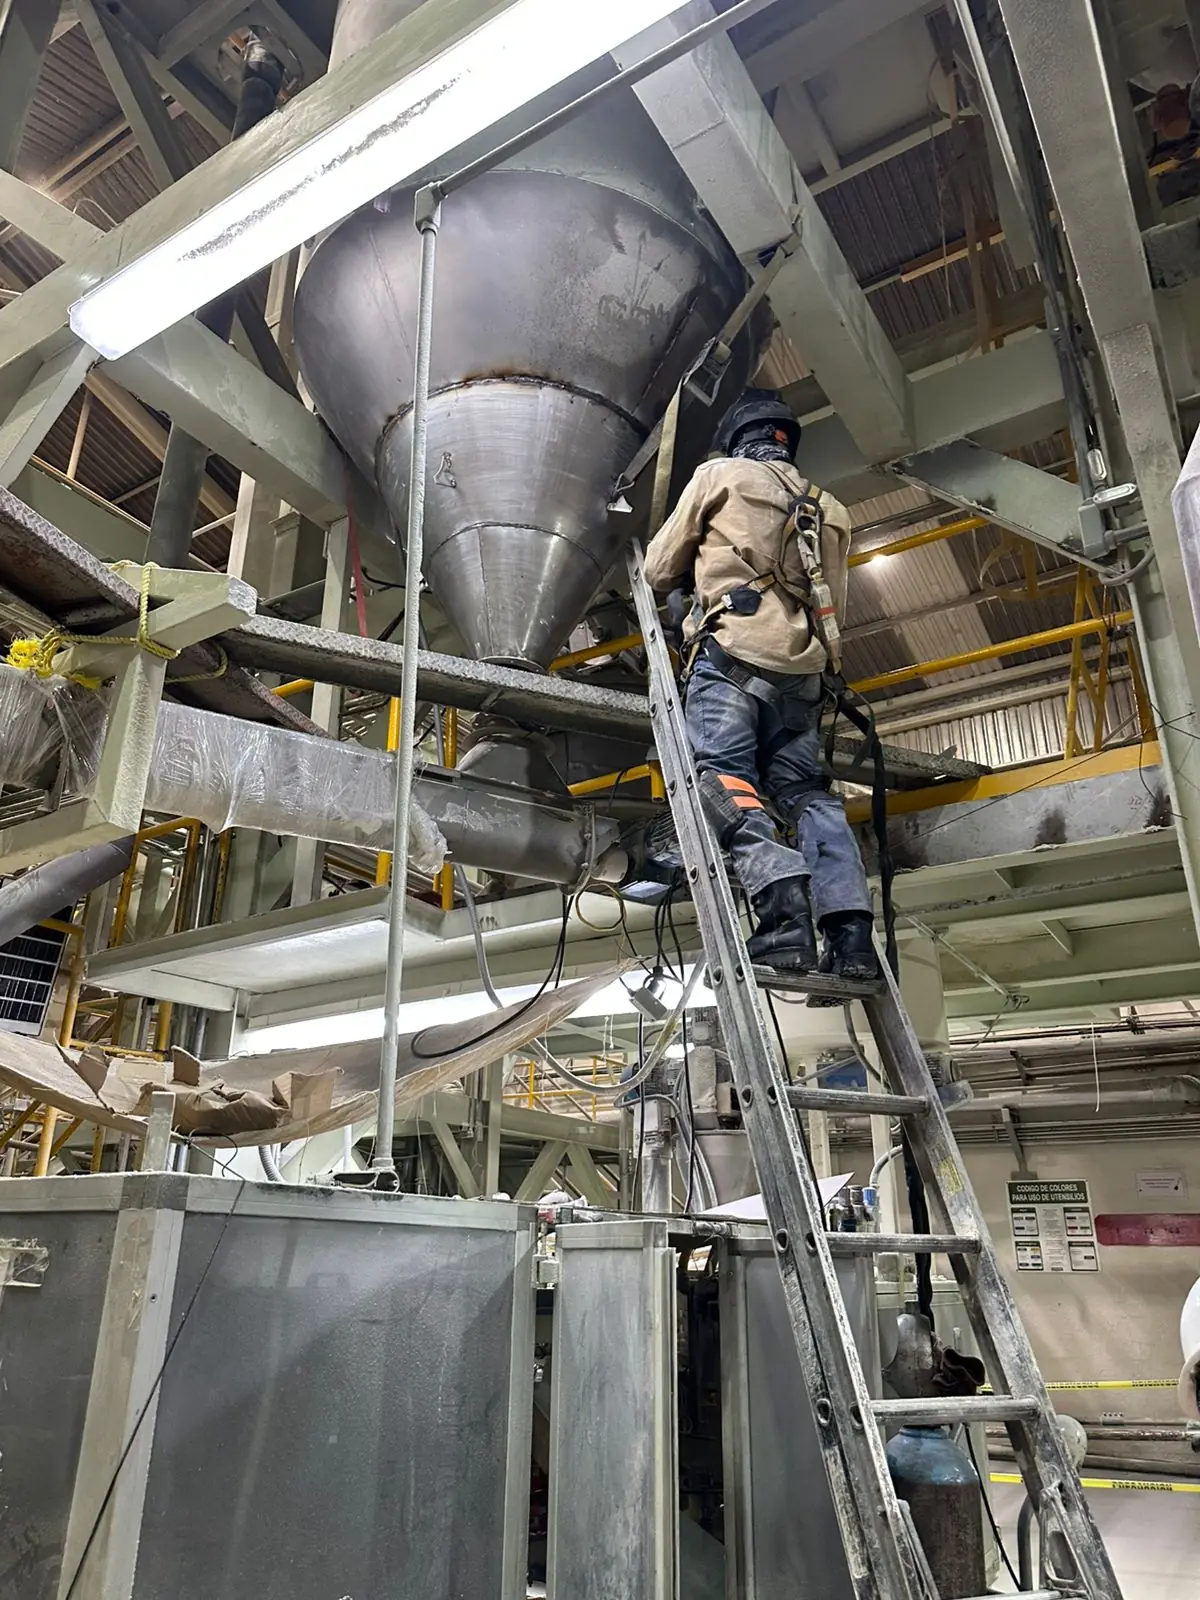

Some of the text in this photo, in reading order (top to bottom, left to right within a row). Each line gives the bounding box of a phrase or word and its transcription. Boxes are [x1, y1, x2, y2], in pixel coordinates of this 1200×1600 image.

[1040, 1184, 1048, 1192] DE
[1049, 1184, 1078, 1192] COLORES
[1012, 1193, 1085, 1201] PARA USO DE UTENSILIOS
